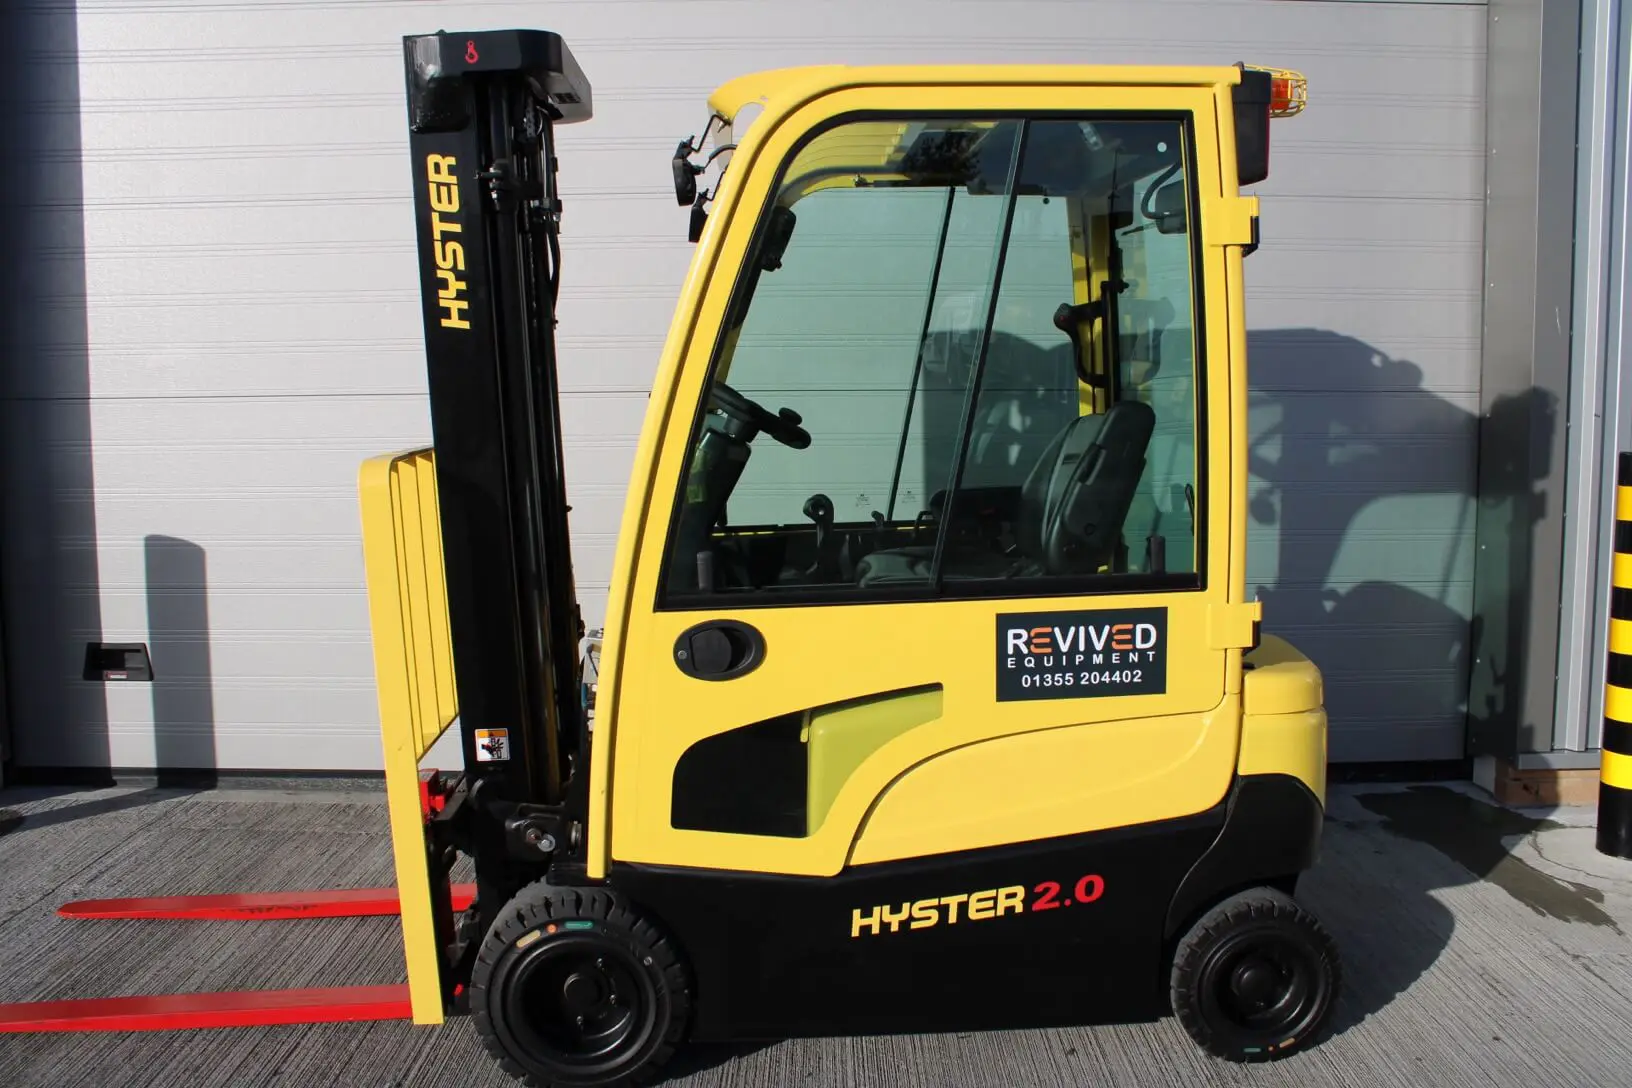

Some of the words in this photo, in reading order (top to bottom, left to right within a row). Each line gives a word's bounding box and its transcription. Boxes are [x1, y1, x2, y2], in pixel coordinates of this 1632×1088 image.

[426, 153, 470, 330] HYSTER
[1007, 623, 1157, 655] REVIVED
[1007, 651, 1156, 669] EQUIPMENT
[1021, 672, 1075, 688] 01355
[1080, 669, 1143, 686] 204402
[850, 884, 1026, 938] HYSTER
[1031, 874, 1105, 911] 2.0
